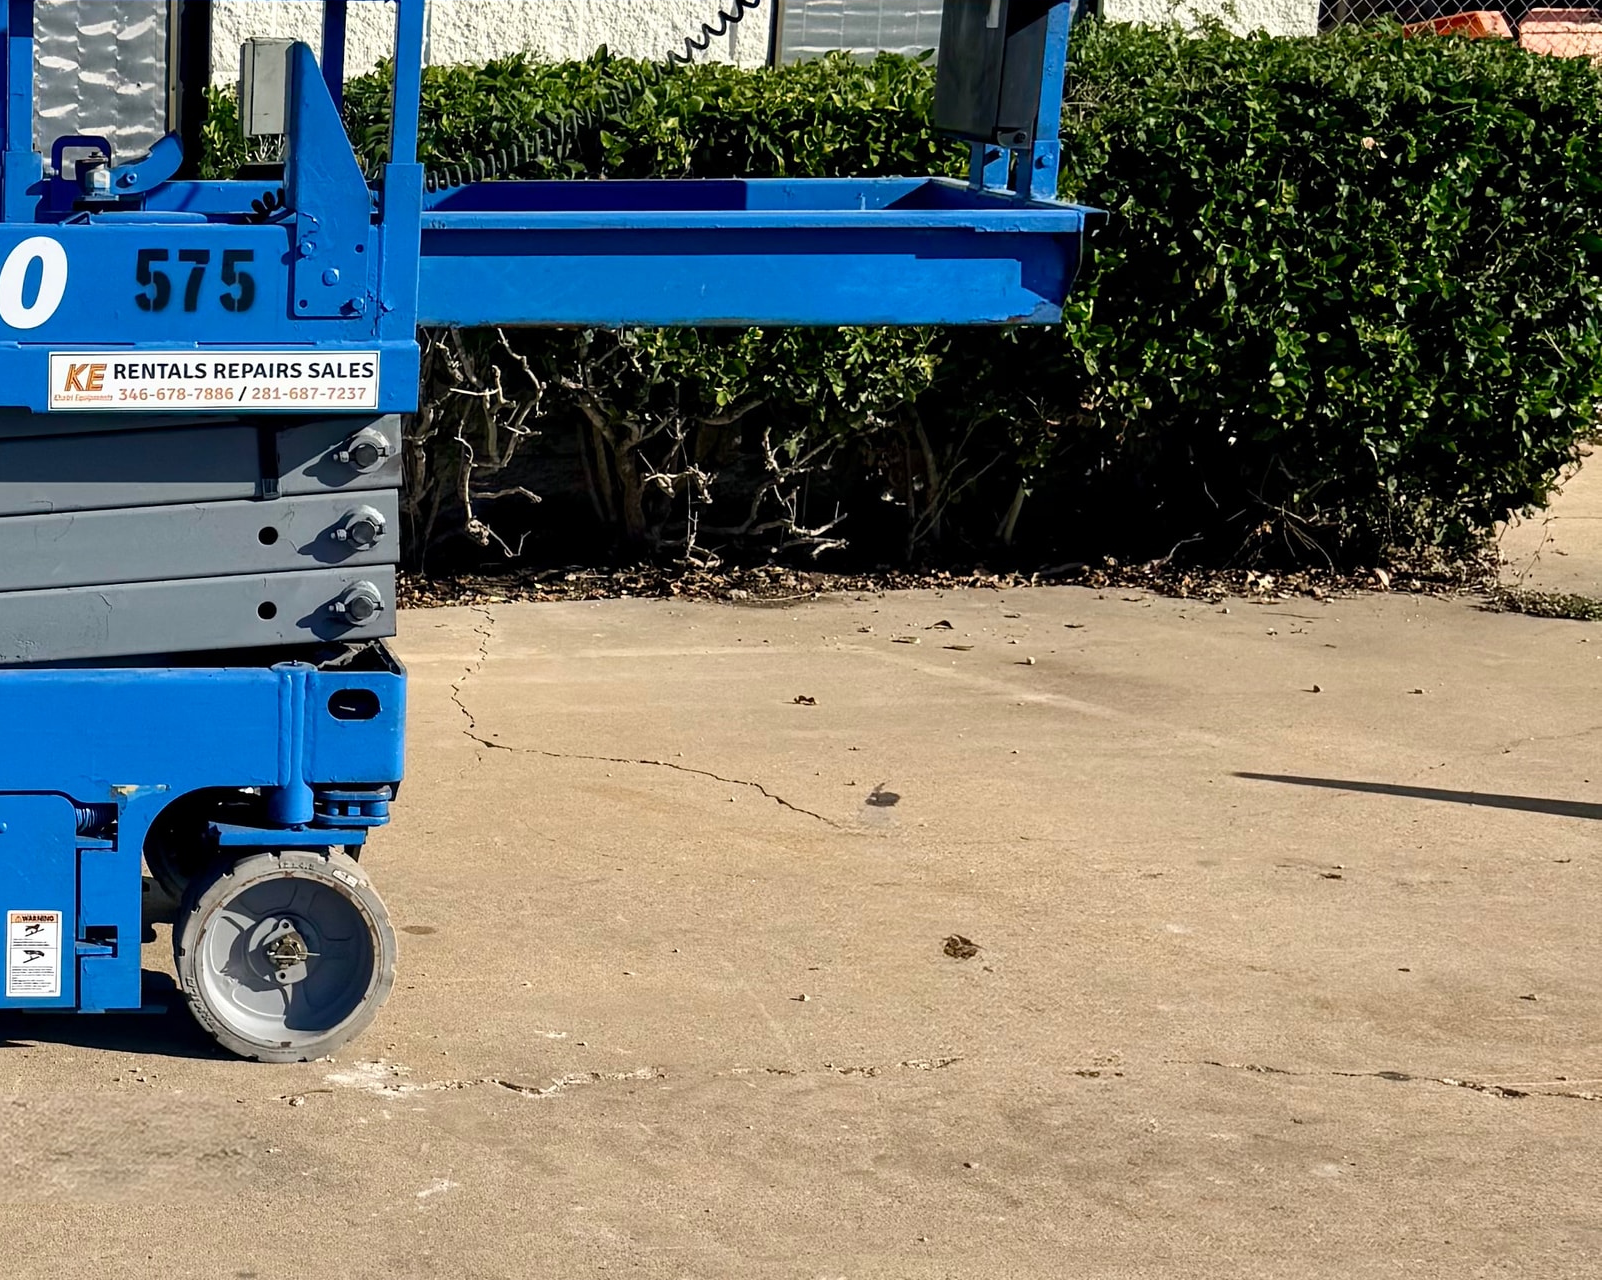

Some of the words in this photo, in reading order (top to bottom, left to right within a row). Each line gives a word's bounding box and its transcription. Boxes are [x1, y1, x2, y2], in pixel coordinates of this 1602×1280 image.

[134, 249, 255, 312] 575
[63, 363, 108, 391] KE
[113, 362, 207, 380] RENTALS
[213, 362, 302, 379] REPAIRS
[308, 361, 374, 379] SALES
[118, 387, 234, 401] 346-678-7886
[251, 386, 367, 400] 281-687-7237
